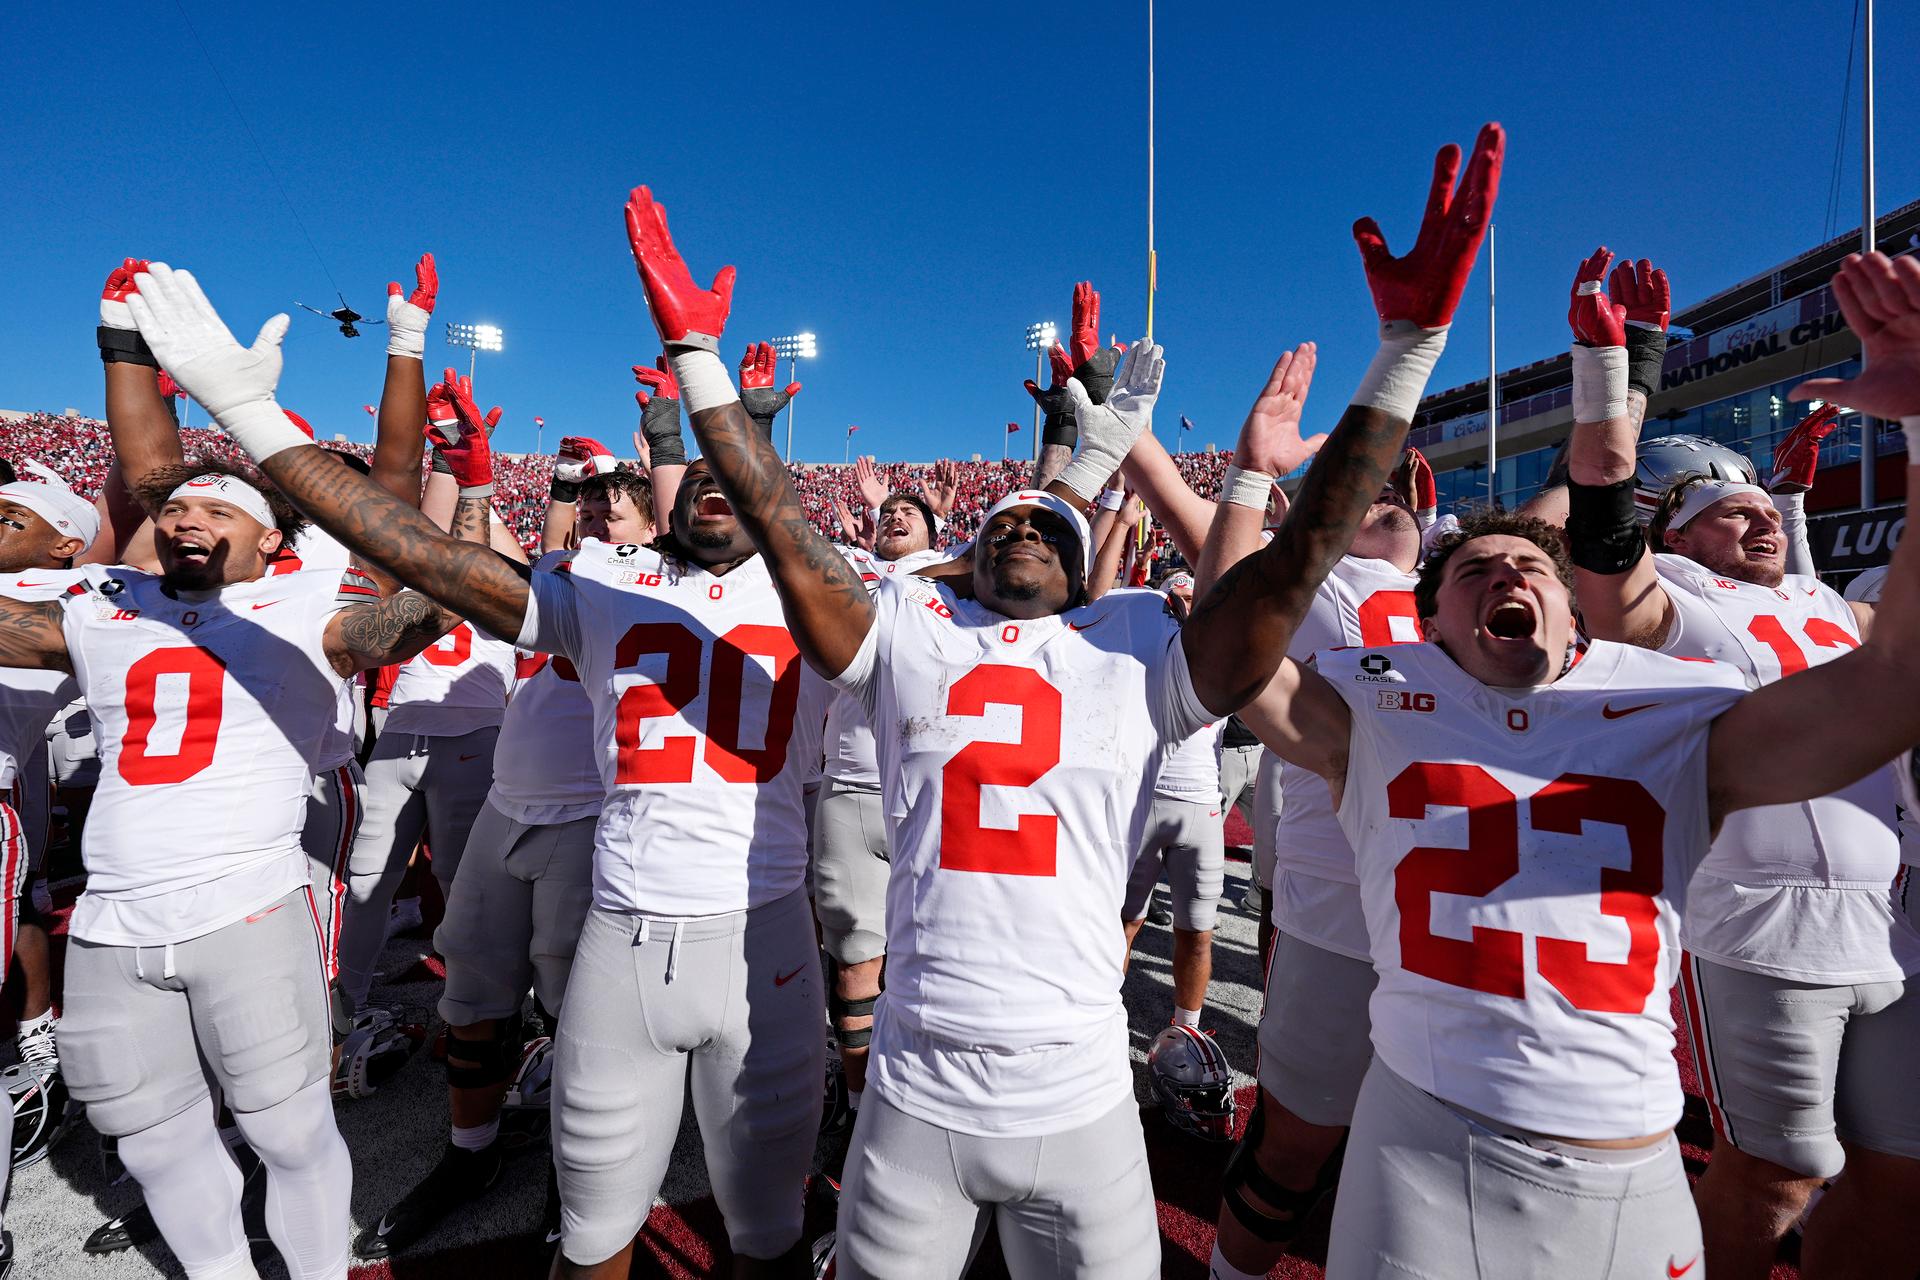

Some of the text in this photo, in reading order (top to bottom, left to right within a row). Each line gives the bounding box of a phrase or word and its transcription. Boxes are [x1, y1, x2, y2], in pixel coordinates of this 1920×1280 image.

[1661, 333, 1786, 391] NATIONAL
[607, 557, 636, 566] CHASE
[1831, 516, 1908, 557] LUC
[118, 646, 226, 786] 0
[614, 623, 801, 784] 20
[1355, 675, 1396, 683] CHASE
[940, 664, 1062, 877] 2
[1386, 761, 1667, 1015] 23
